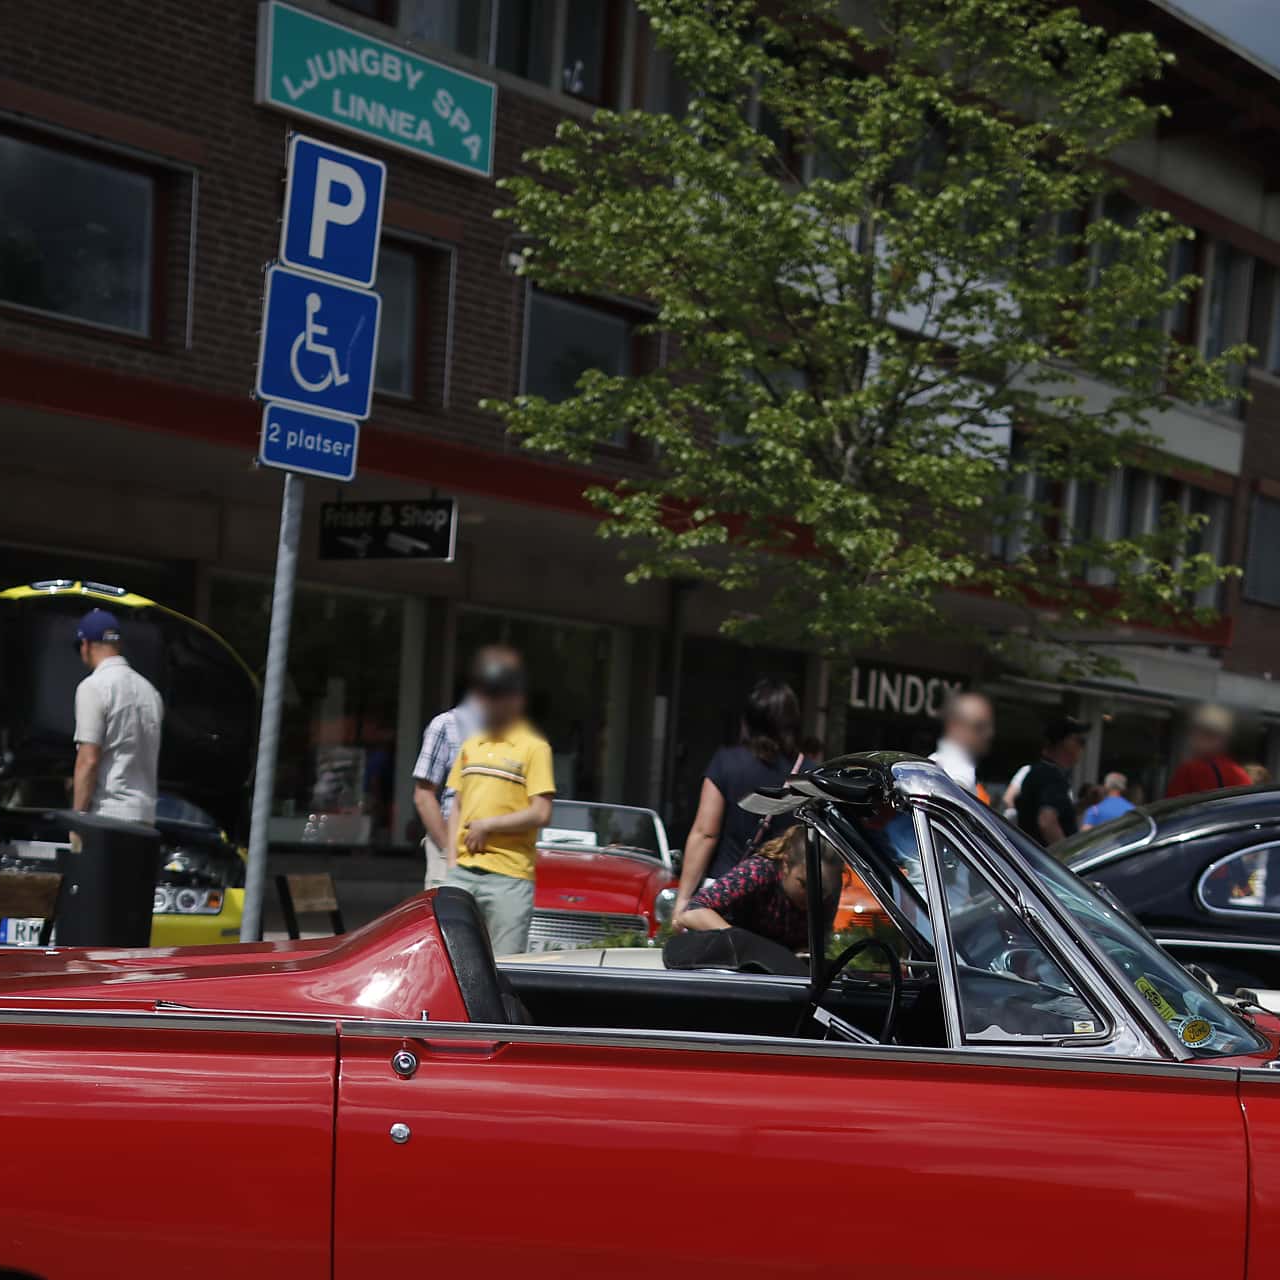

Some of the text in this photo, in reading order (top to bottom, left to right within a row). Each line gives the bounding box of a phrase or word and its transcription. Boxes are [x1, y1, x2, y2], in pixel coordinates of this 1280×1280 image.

[281, 47, 482, 162] LJUNGBY SPA
[331, 88, 436, 147] LINNEA
[308, 157, 367, 260] P
[268, 422, 353, 459] 2 platser
[378, 504, 395, 527] &
[399, 505, 449, 533] Shop
